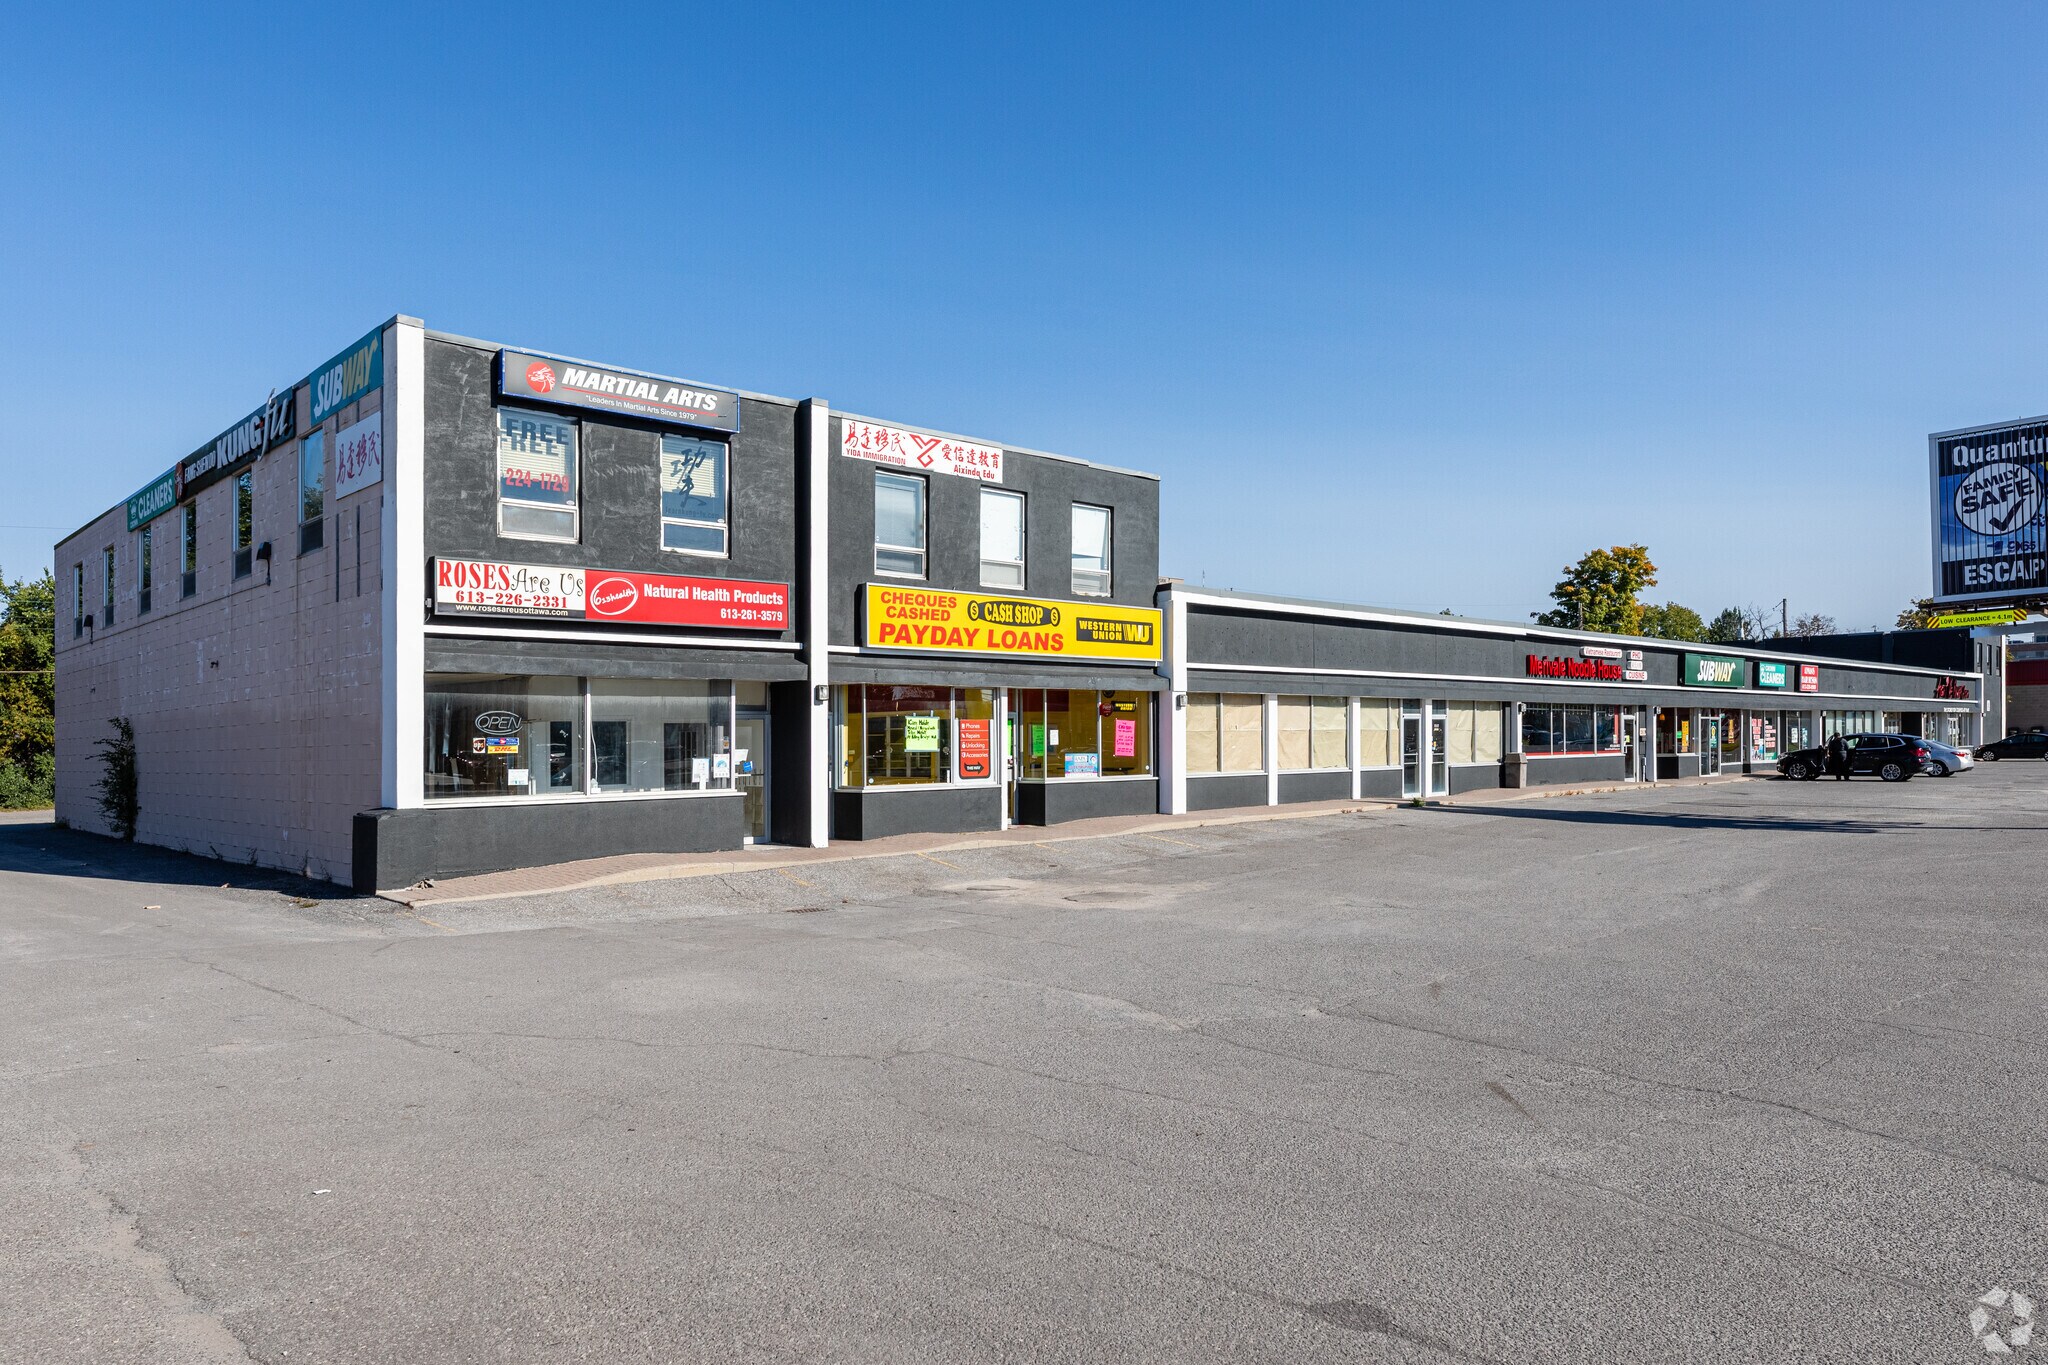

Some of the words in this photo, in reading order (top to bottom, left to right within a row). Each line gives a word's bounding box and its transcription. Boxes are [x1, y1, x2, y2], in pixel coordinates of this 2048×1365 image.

[313, 335, 379, 420] SUBWAY
[562, 367, 659, 402] MARTIAL
[663, 387, 718, 411] ARTS
[586, 395, 615, 407] "Leaders
[624, 401, 646, 412] Martial
[647, 405, 660, 415] Arts
[661, 408, 677, 418] Since
[679, 411, 697, 421] 1979"
[507, 418, 569, 445] FREE
[217, 415, 262, 470] KUNG
[846, 448, 861, 458] YIDA
[863, 451, 906, 465] IMMIGRATION
[506, 468, 569, 492] 224-1729
[954, 464, 980, 478] Aixinda
[983, 470, 995, 480] Edu
[1964, 467, 2020, 496] FAMILY
[138, 478, 173, 520] CLEANERS
[1963, 478, 2035, 515] SAFE
[438, 561, 511, 591] ROSES
[511, 568, 550, 593] Are
[560, 573, 583, 597] Us
[456, 590, 568, 609] 613-226-2331
[644, 584, 689, 600] Natural
[692, 587, 730, 602] Health
[734, 589, 783, 605] Products
[881, 591, 957, 608] CHEQUES
[455, 604, 569, 616] www.rosesareusottawa.com
[720, 608, 783, 621] 613-261-3579
[886, 606, 951, 621] CASHED
[1956, 615, 1991, 624] CLEARANCE
[1079, 620, 1122, 632] WESTERN
[1092, 630, 1122, 640] UNION
[879, 623, 980, 647] PAYDAY
[987, 629, 1064, 651] LOANS
[1528, 655, 1566, 676] Merivale
[1567, 658, 1596, 678] Noodle
[1596, 659, 1622, 680] House
[1697, 660, 1736, 682] SUBWAY
[1761, 671, 1785, 685] CLEANERS
[478, 716, 522, 728] OPEN
